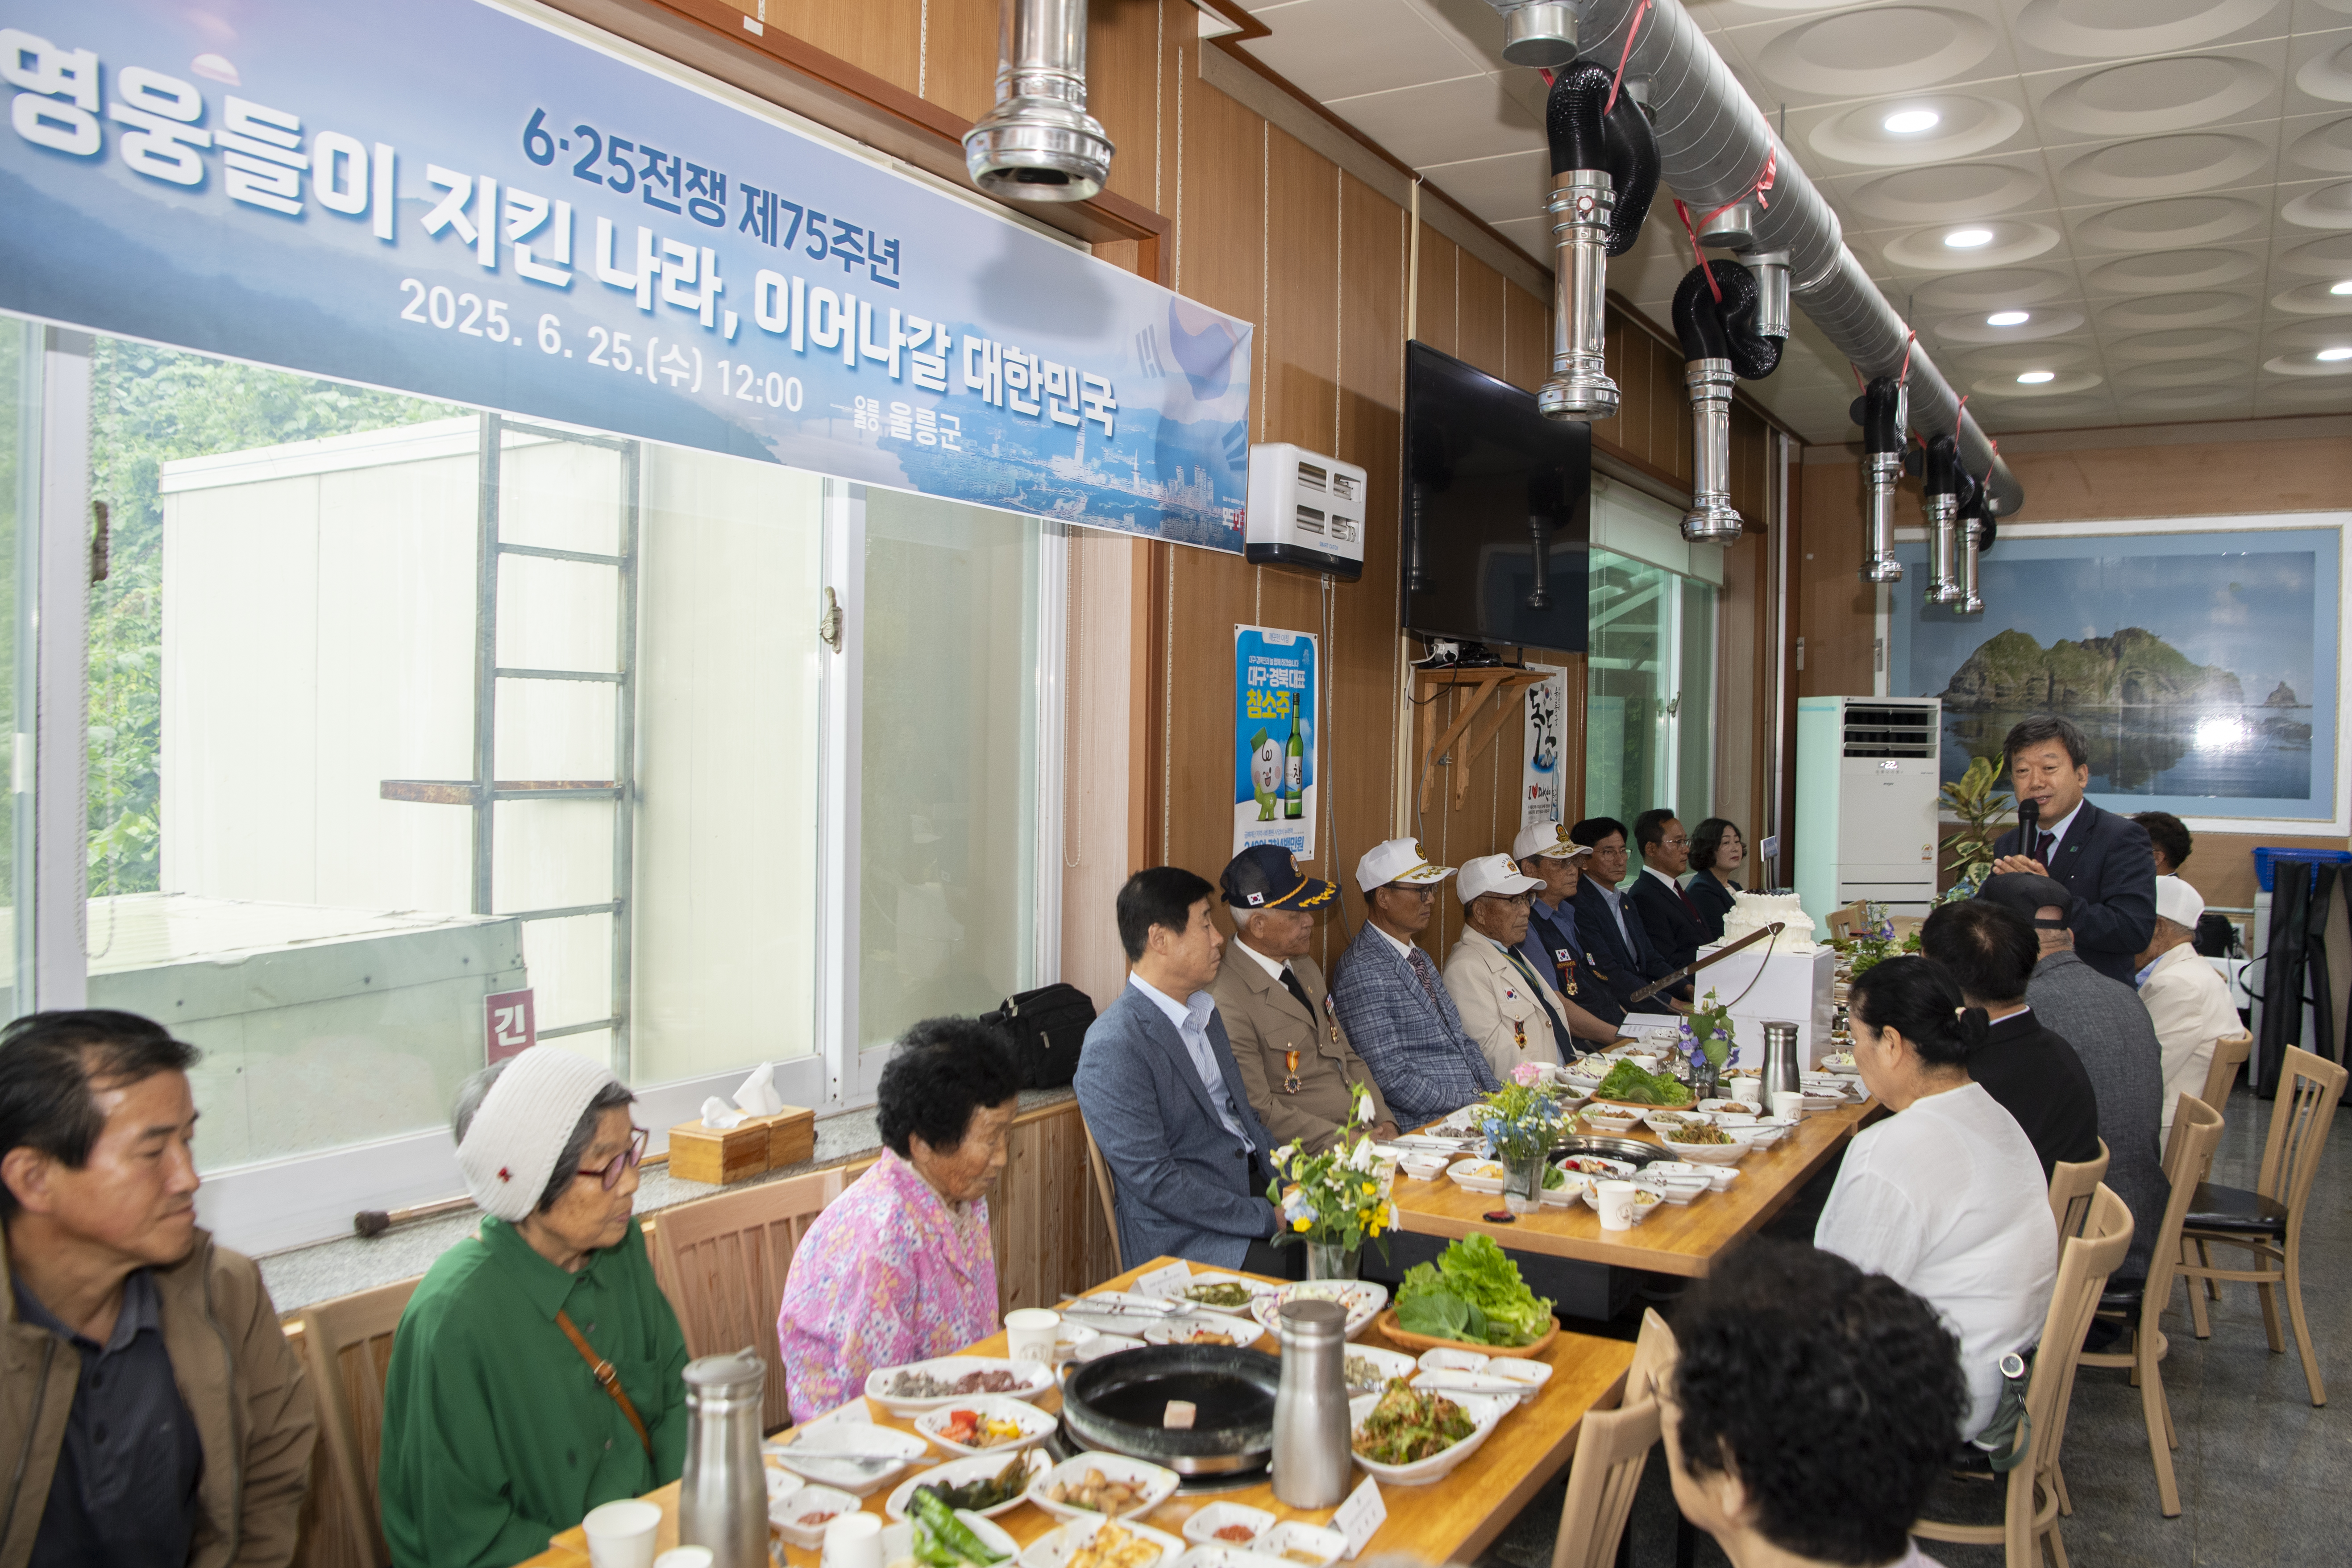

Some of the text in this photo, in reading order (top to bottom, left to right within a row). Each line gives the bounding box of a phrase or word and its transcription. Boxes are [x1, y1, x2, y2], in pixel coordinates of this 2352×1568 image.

[0, 28, 1117, 437] 영웅들이 지킨 나라, 이어나갈 대한민국
[523, 107, 900, 290] 6·25전쟁 제75주년
[400, 278, 803, 412] 2025. 6. 25.(수) 12:00
[889, 401, 962, 452] 울릉군
[1247, 689, 1290, 720] 참소주
[1293, 764, 1302, 785] 참
